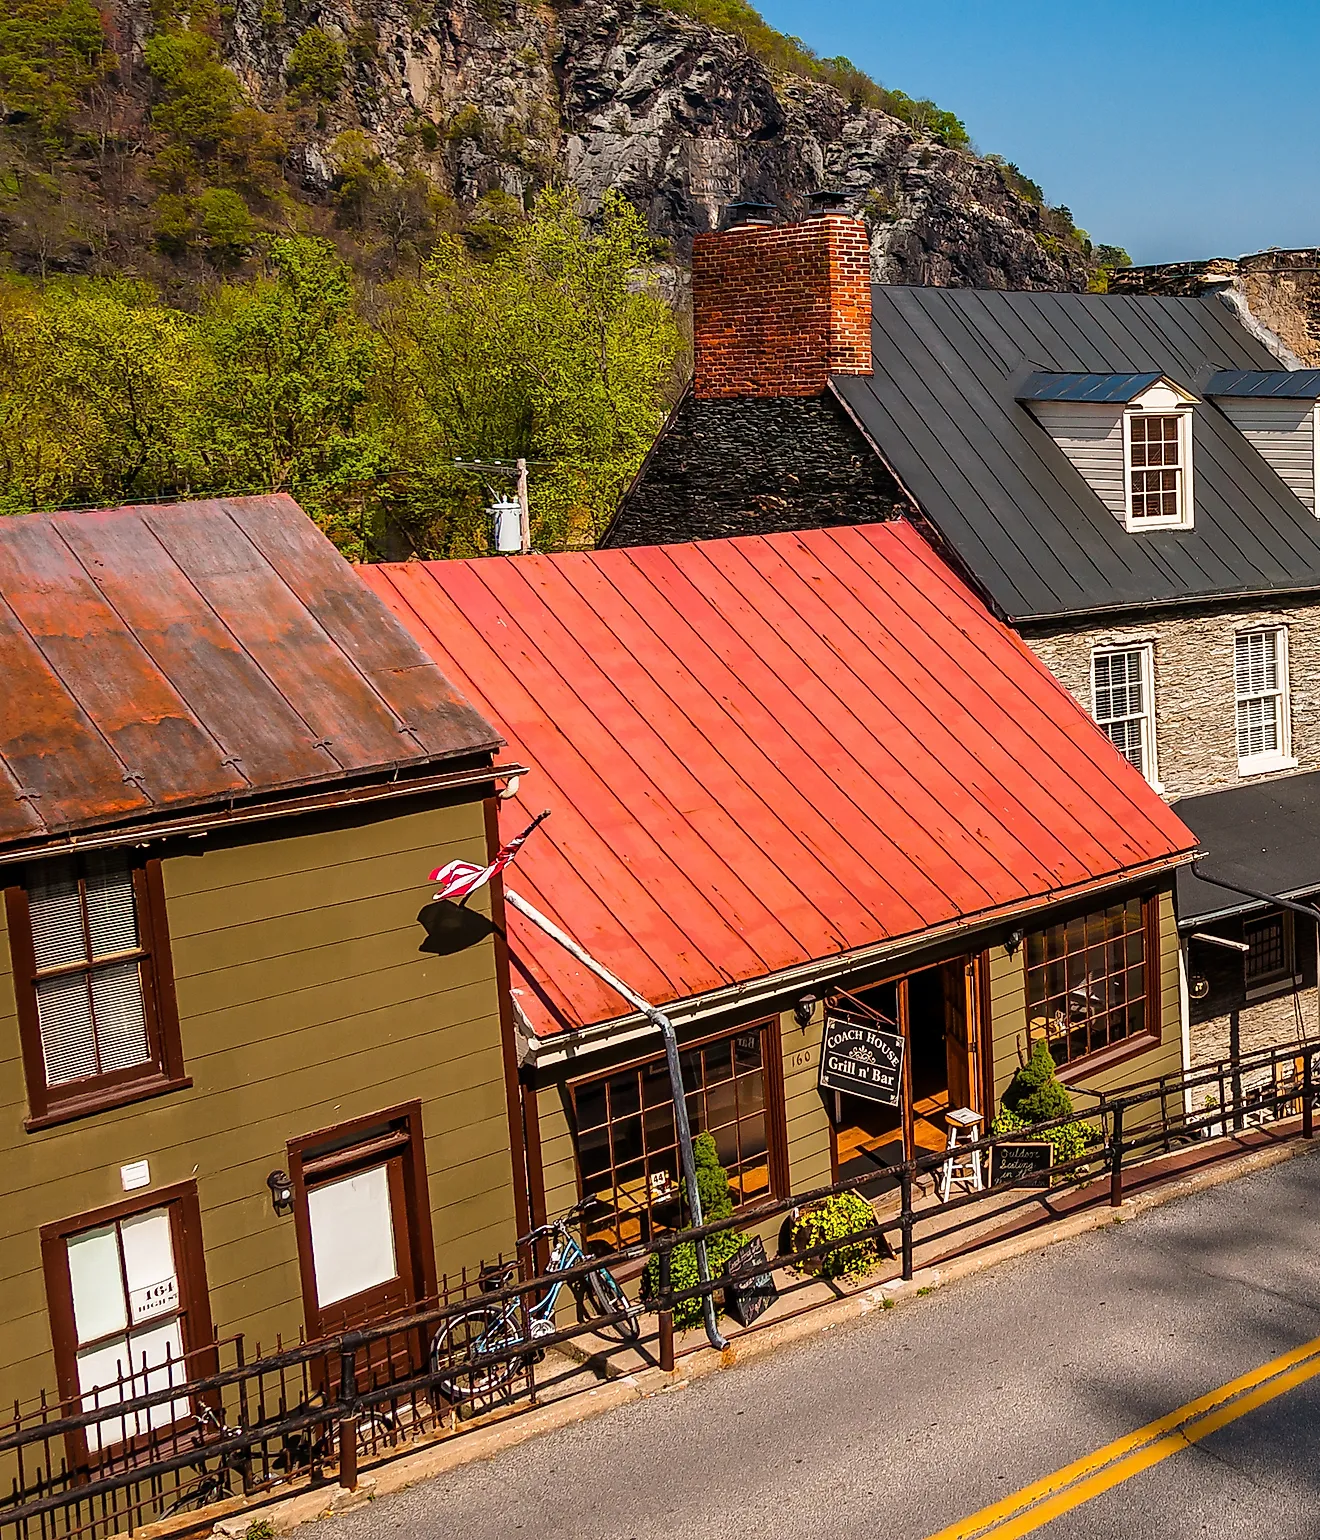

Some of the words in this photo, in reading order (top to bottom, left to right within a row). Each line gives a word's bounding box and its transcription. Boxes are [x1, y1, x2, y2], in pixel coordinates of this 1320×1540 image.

[792, 1051, 811, 1067] 160
[827, 1030, 864, 1049] COACH
[866, 1032, 900, 1068] HOUSE
[828, 1056, 855, 1075] Grill
[859, 1067, 870, 1079] n'
[871, 1068, 895, 1086] Bar
[146, 1282, 174, 1300] 164
